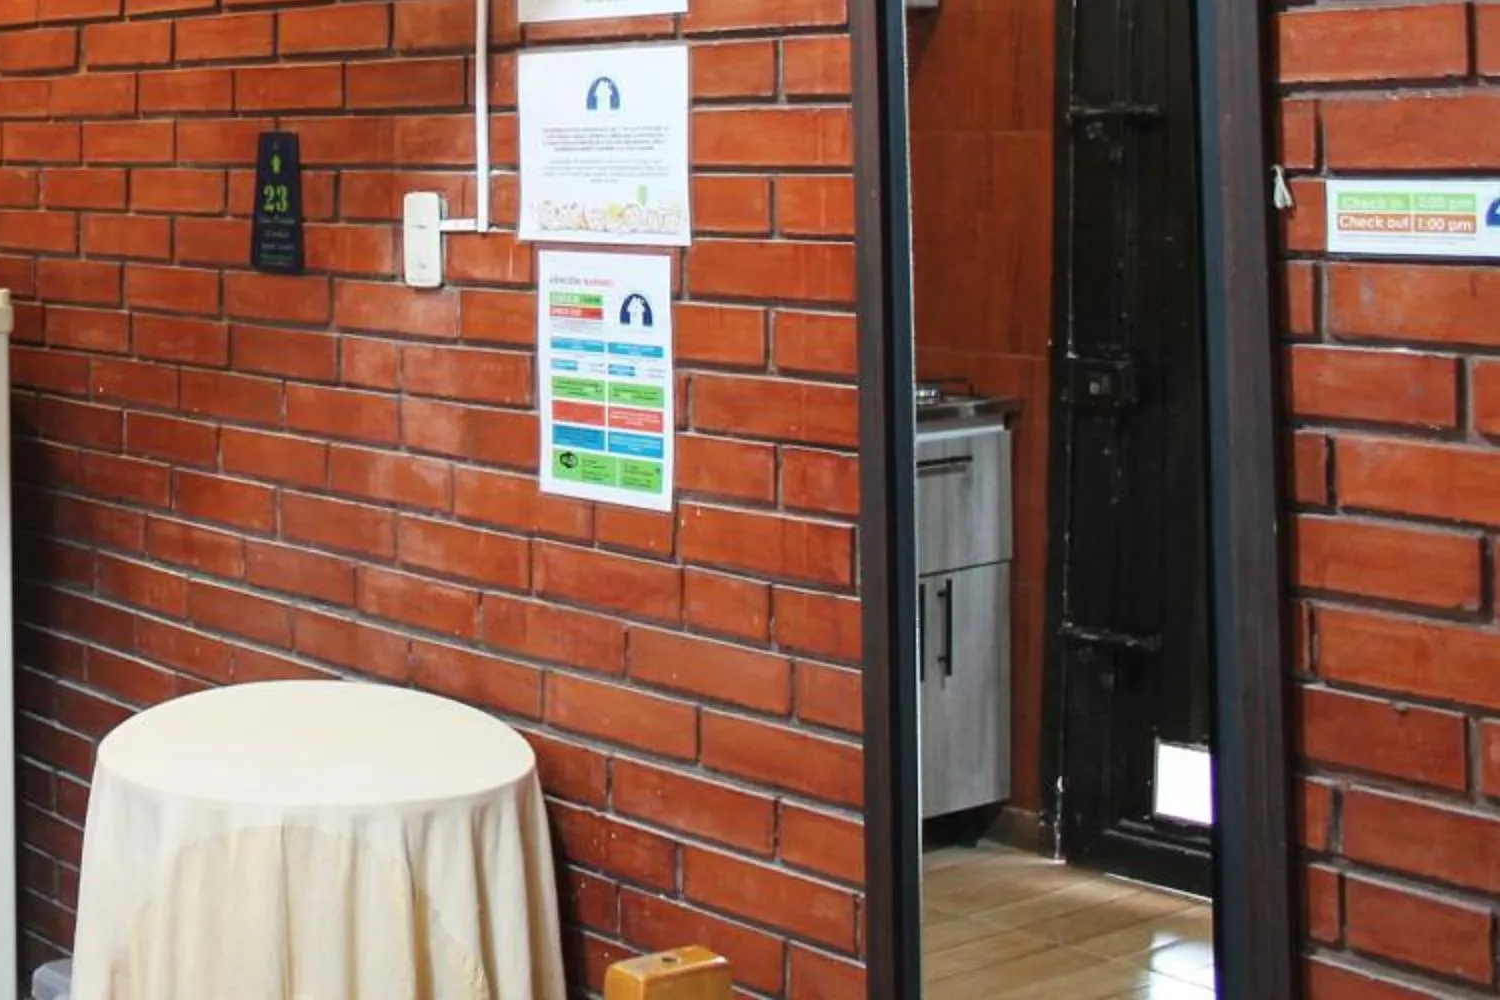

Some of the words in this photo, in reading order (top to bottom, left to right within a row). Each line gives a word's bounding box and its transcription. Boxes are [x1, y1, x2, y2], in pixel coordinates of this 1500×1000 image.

[263, 184, 289, 213] 23
[1339, 215, 1383, 229] Check
[1387, 216, 1409, 230] out
[1447, 220, 1474, 232] pm
